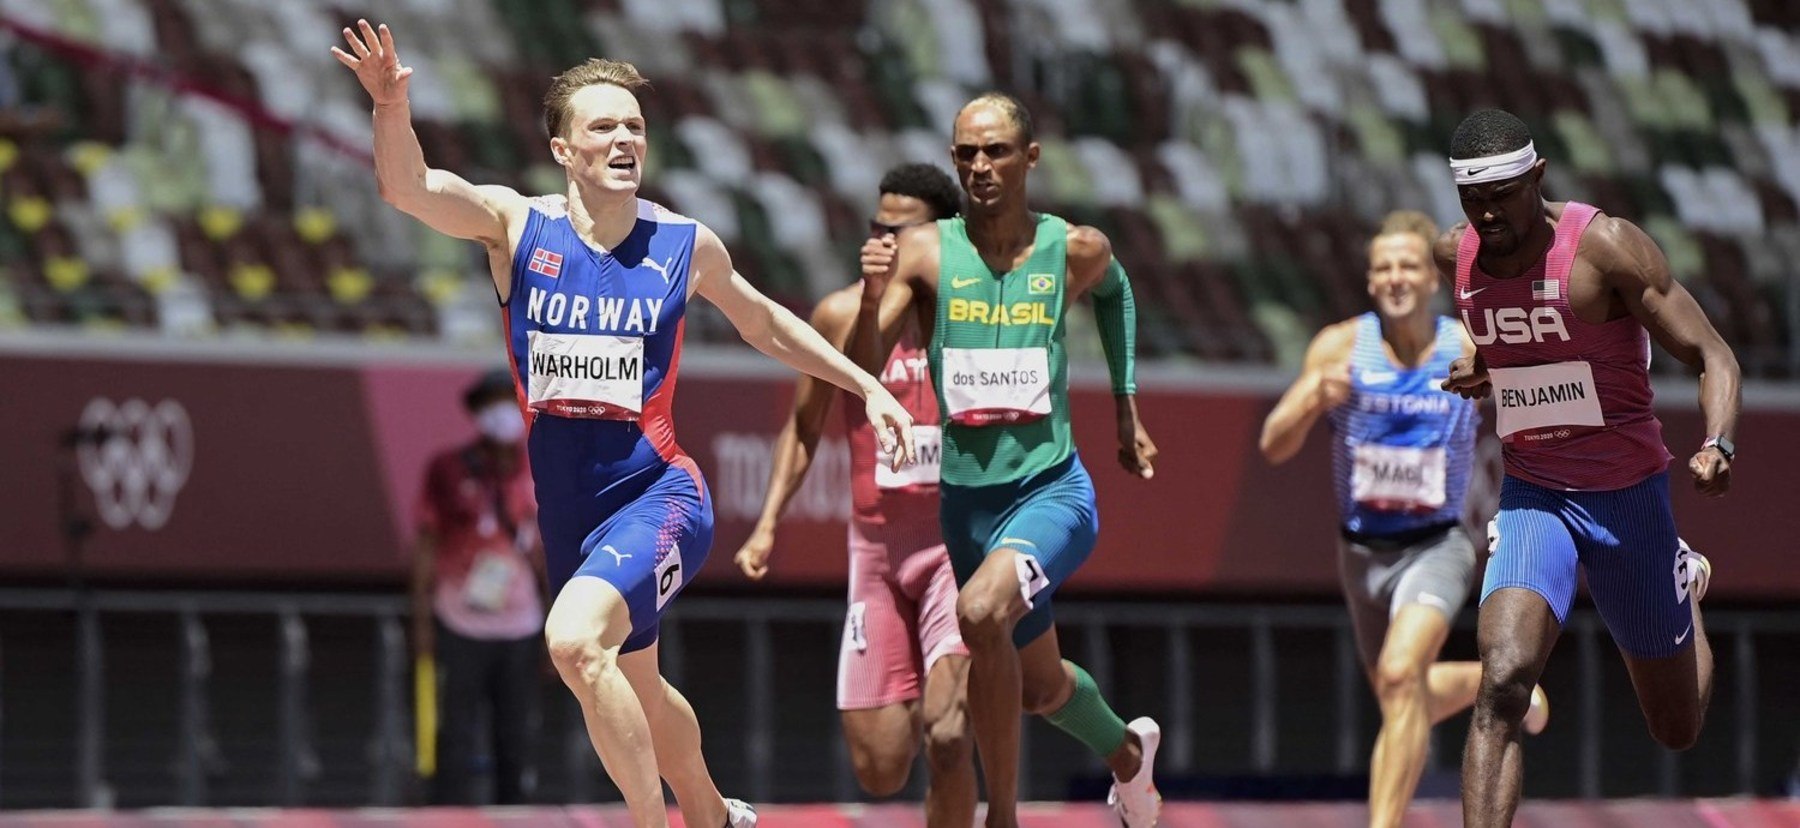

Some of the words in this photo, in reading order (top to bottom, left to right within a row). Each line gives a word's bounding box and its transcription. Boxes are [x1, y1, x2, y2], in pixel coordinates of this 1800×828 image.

[527, 287, 662, 330] NORWAY
[948, 298, 1054, 326] BRASIL
[1461, 306, 1571, 346] USA
[531, 350, 638, 381] WARHOLM
[953, 370, 975, 386] dos
[980, 370, 1039, 387] SANTOS
[1501, 380, 1585, 408] BENJAMIN
[660, 563, 680, 596] 6
